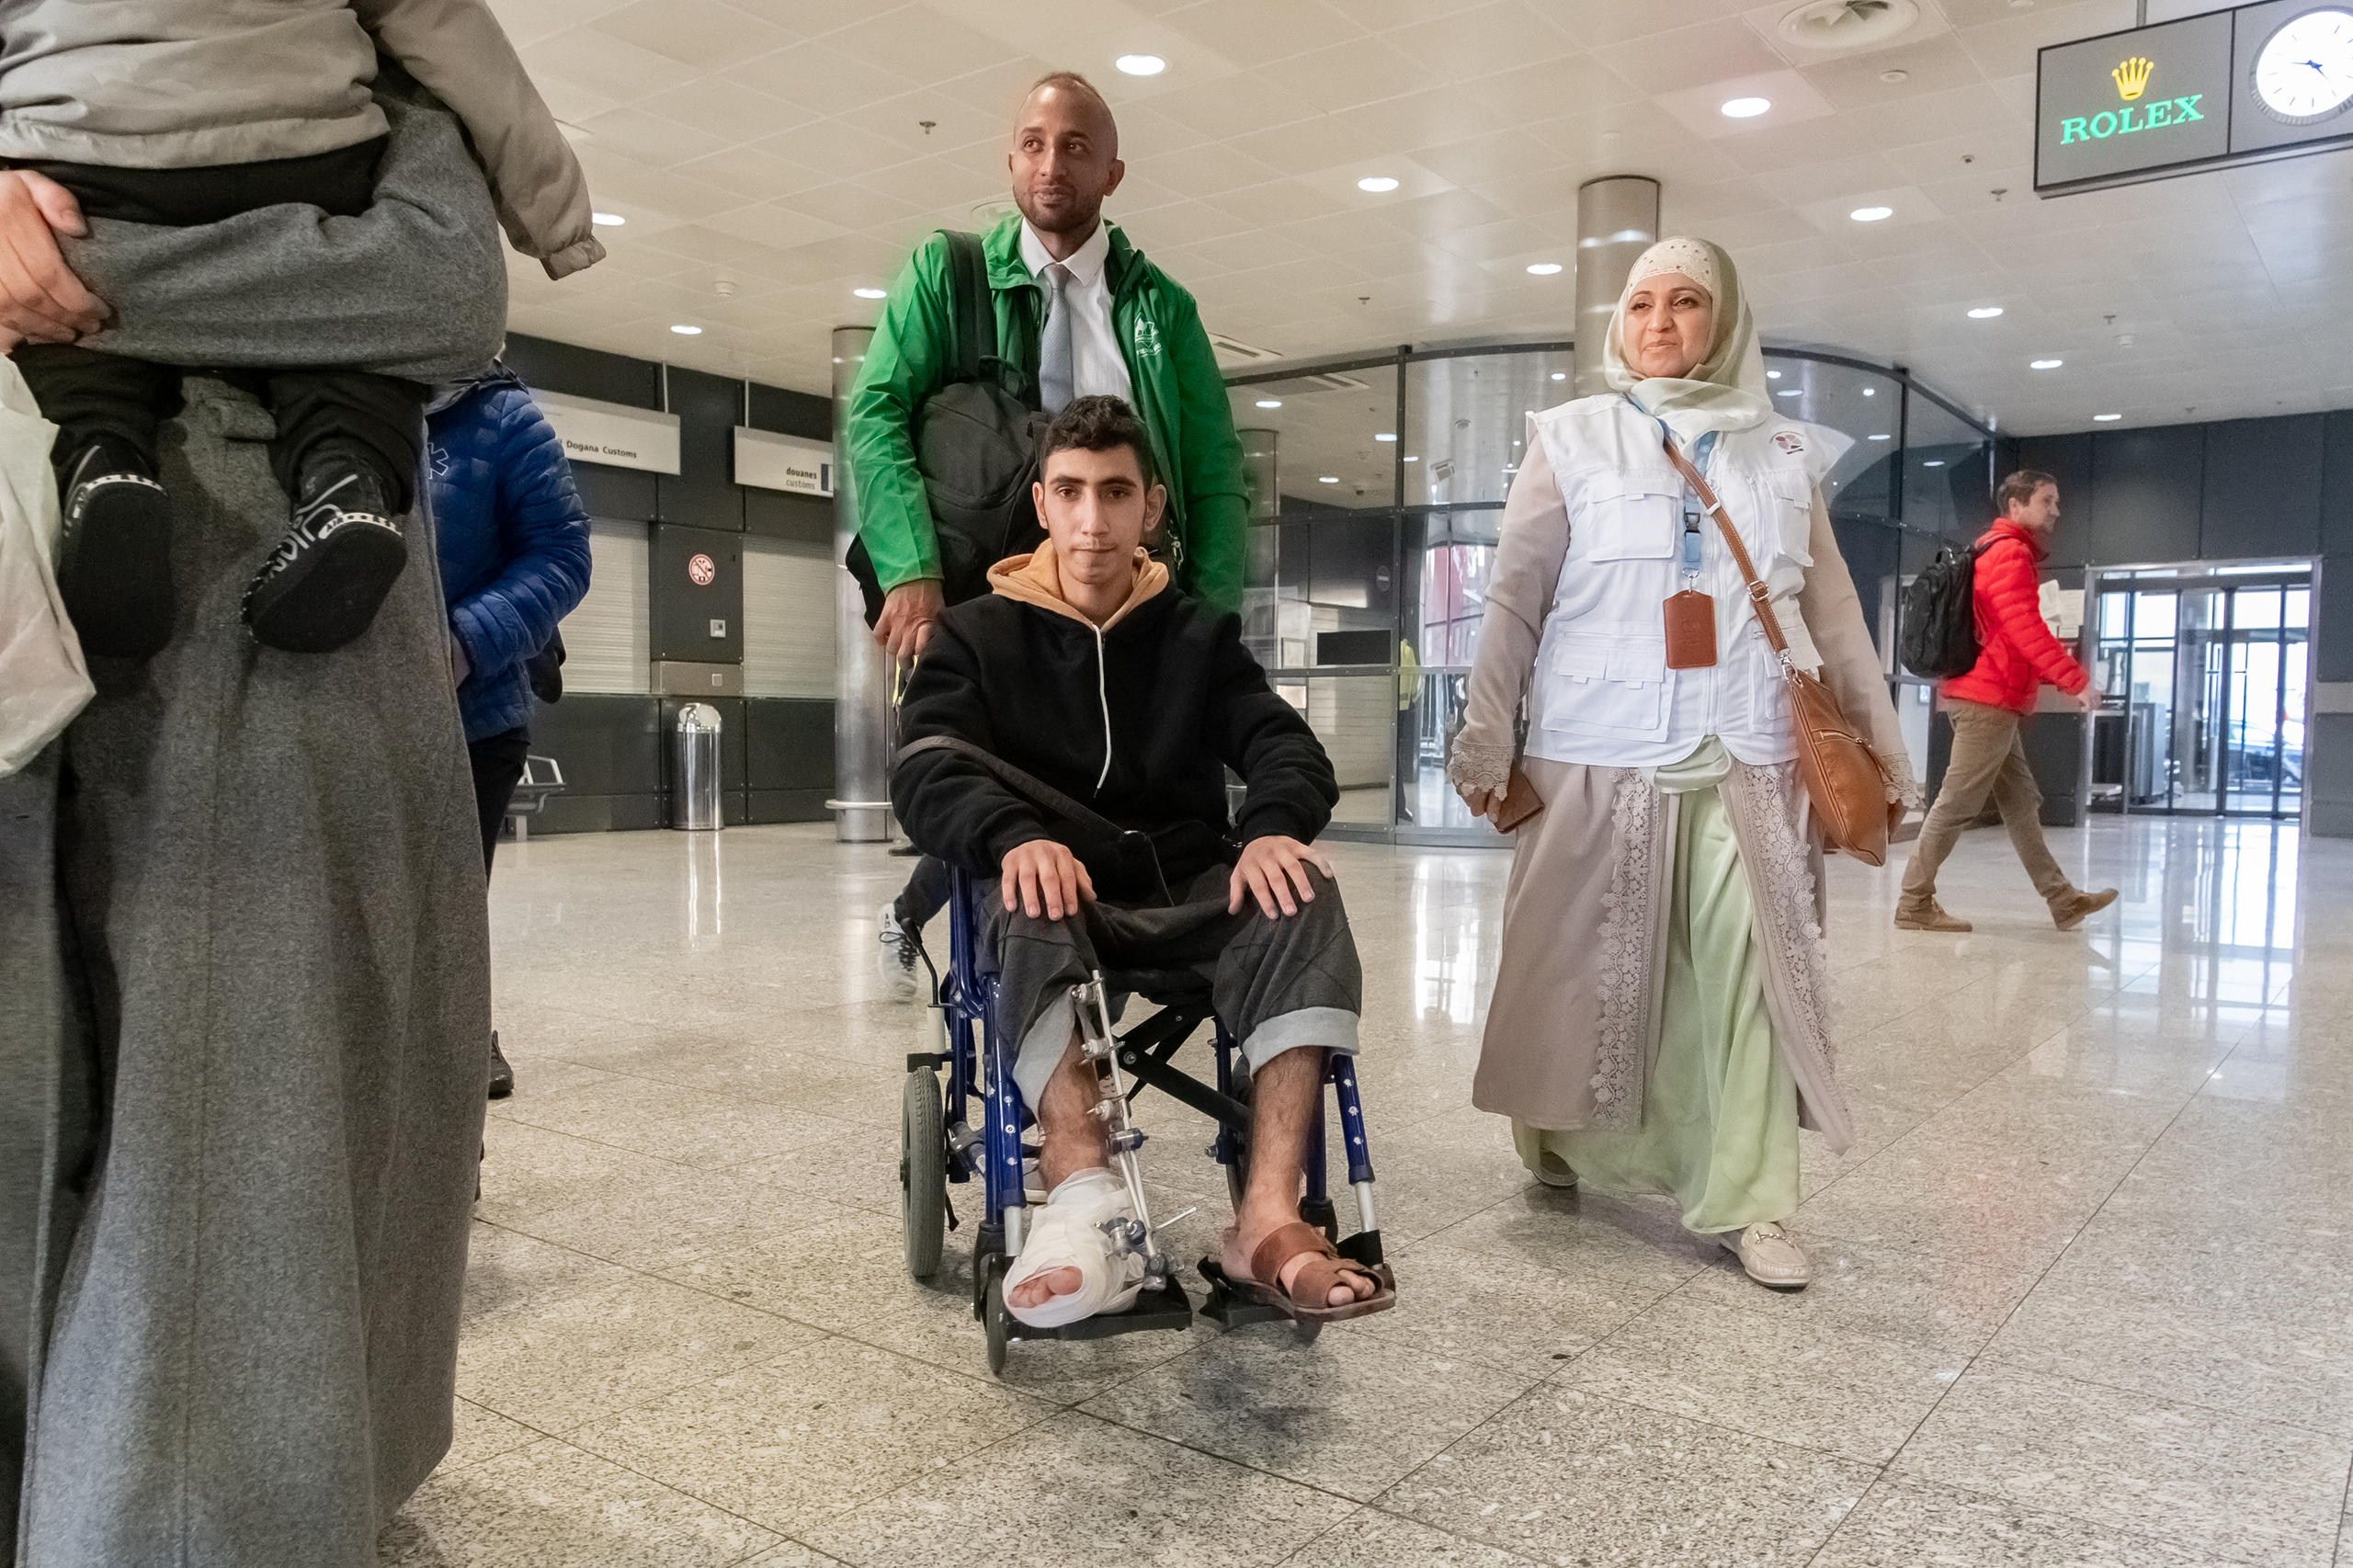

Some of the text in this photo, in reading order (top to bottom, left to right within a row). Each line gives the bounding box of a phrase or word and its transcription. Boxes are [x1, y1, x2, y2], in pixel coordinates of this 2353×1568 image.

[2060, 94, 2204, 145] ROLEX
[566, 439, 599, 453] Dogana
[602, 446, 638, 459] Customs
[786, 466, 817, 479] douanes
[786, 479, 816, 491] customs
